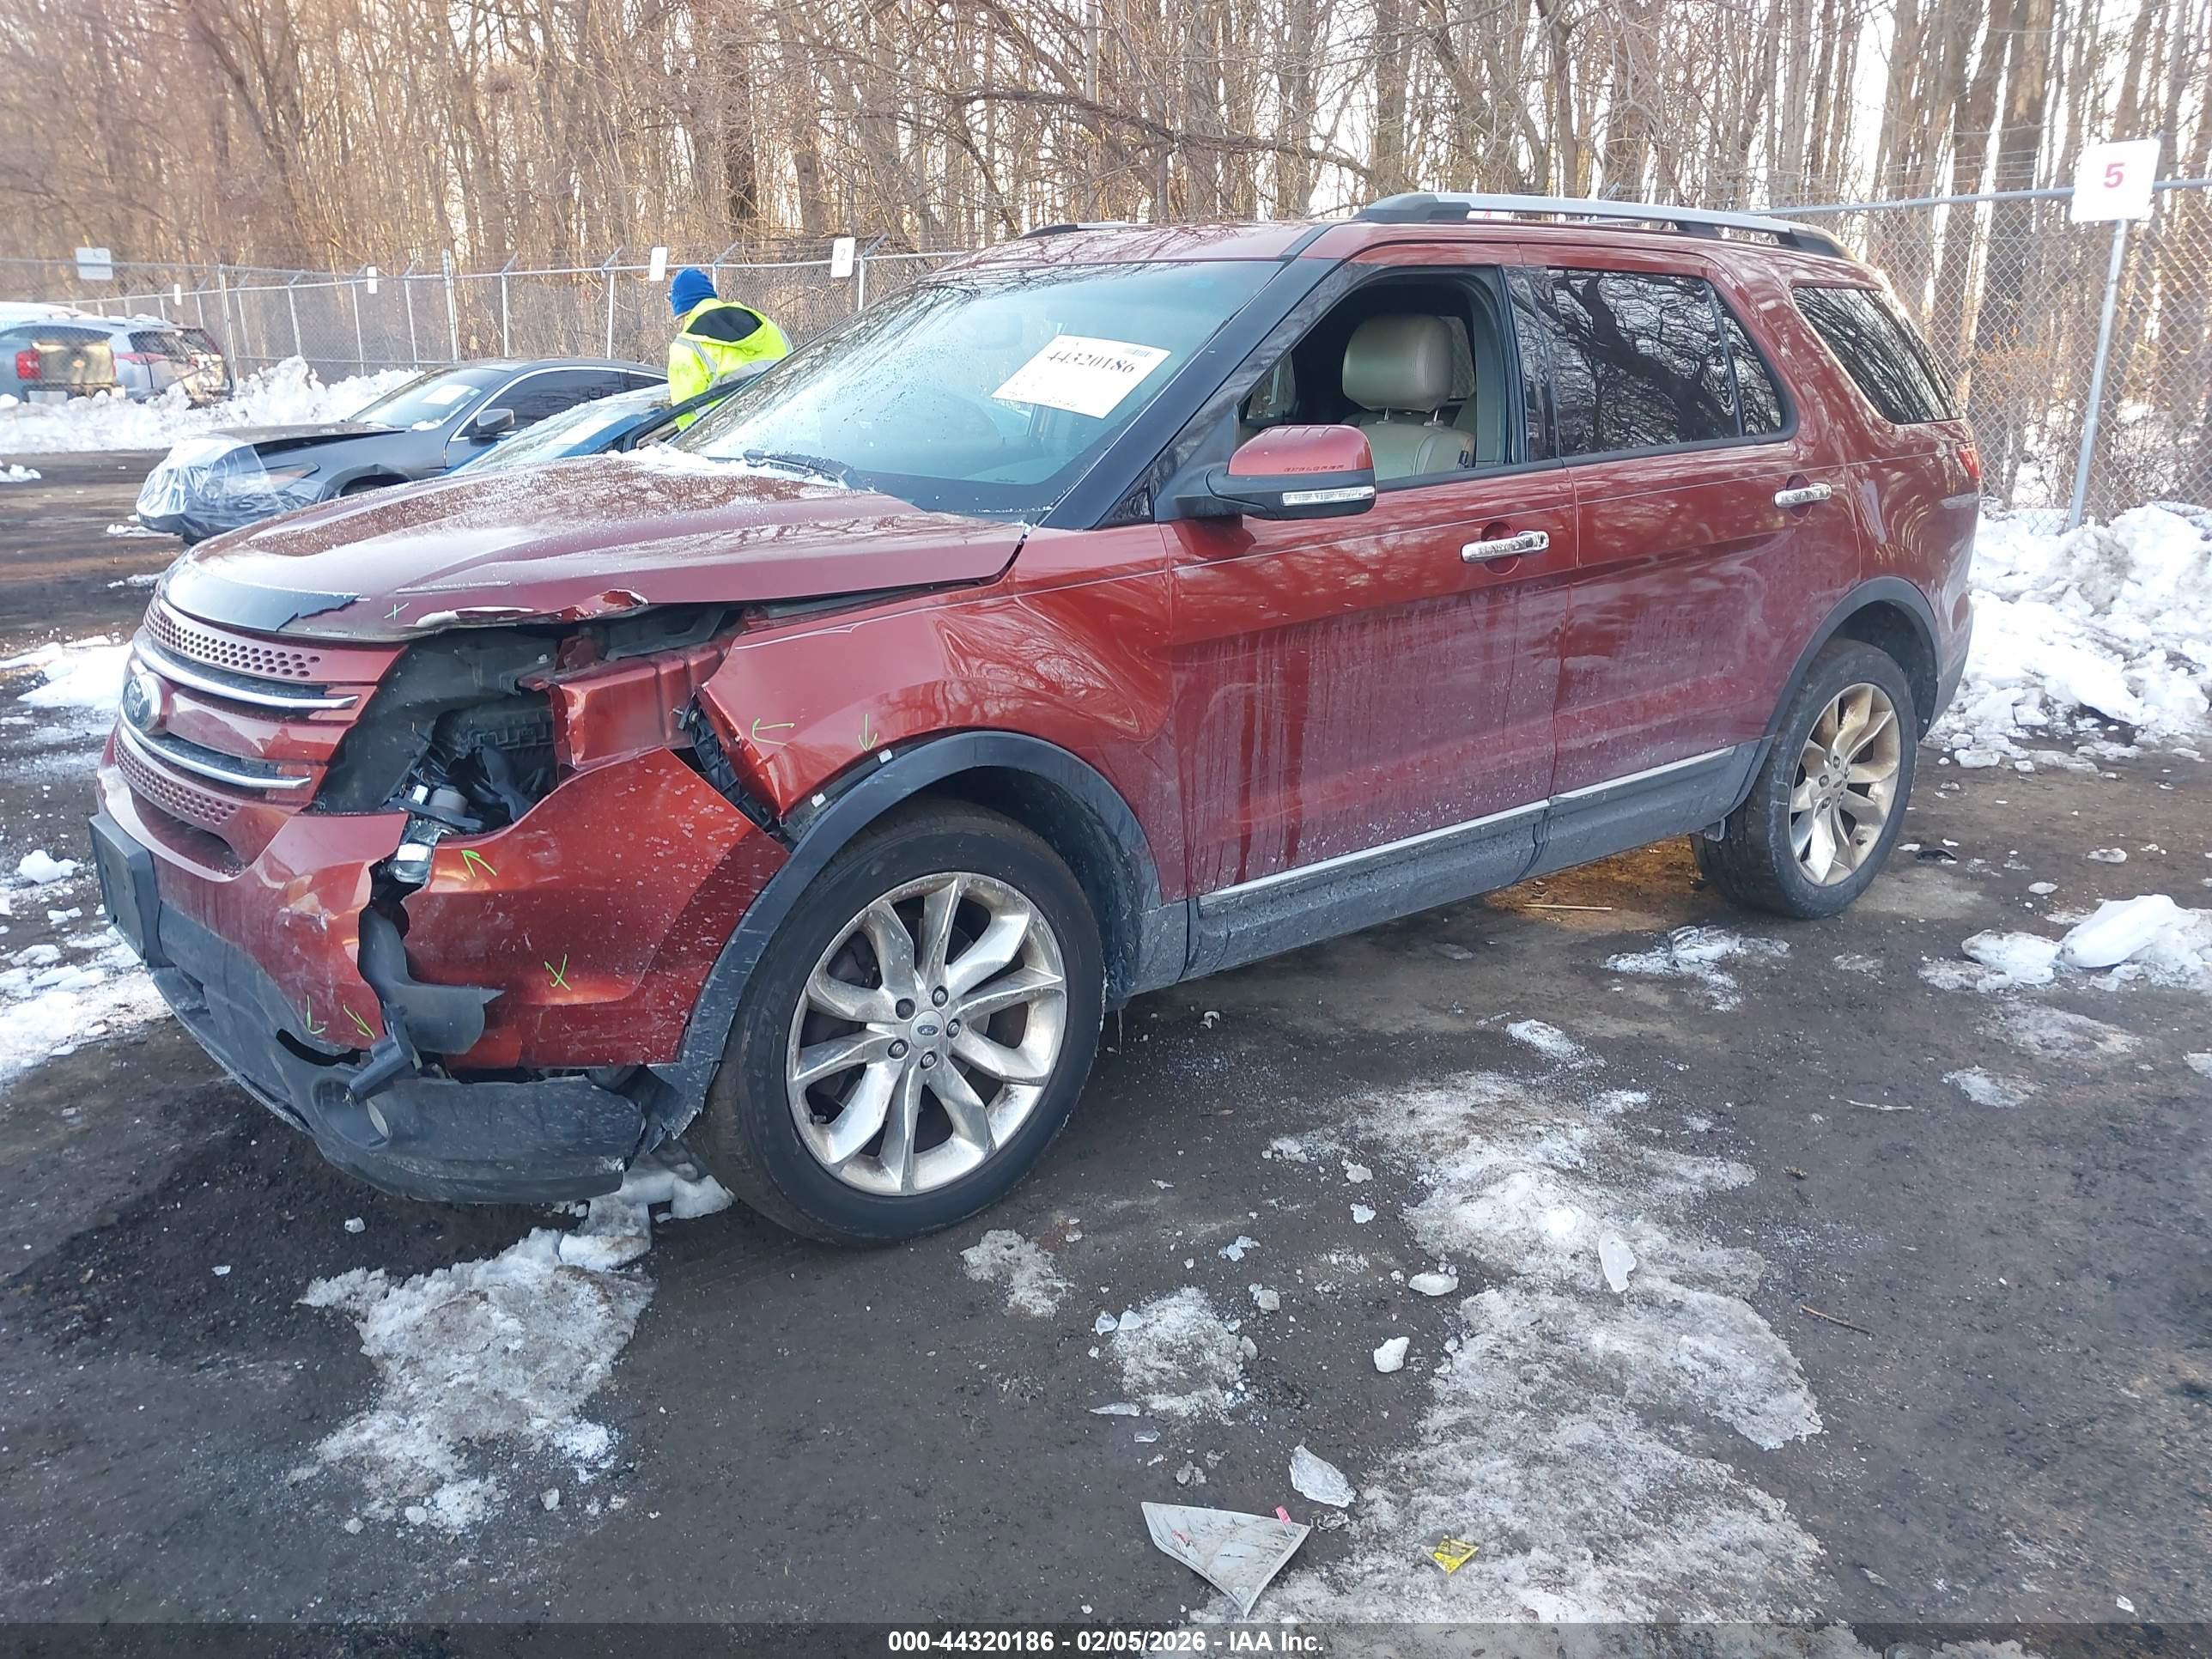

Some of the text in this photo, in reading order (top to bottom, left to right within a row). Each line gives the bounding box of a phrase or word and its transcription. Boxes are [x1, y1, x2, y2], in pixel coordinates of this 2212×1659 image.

[2104, 162, 2125, 188] 5
[839, 248, 846, 261] 2
[1046, 351, 1135, 374] 44320186
